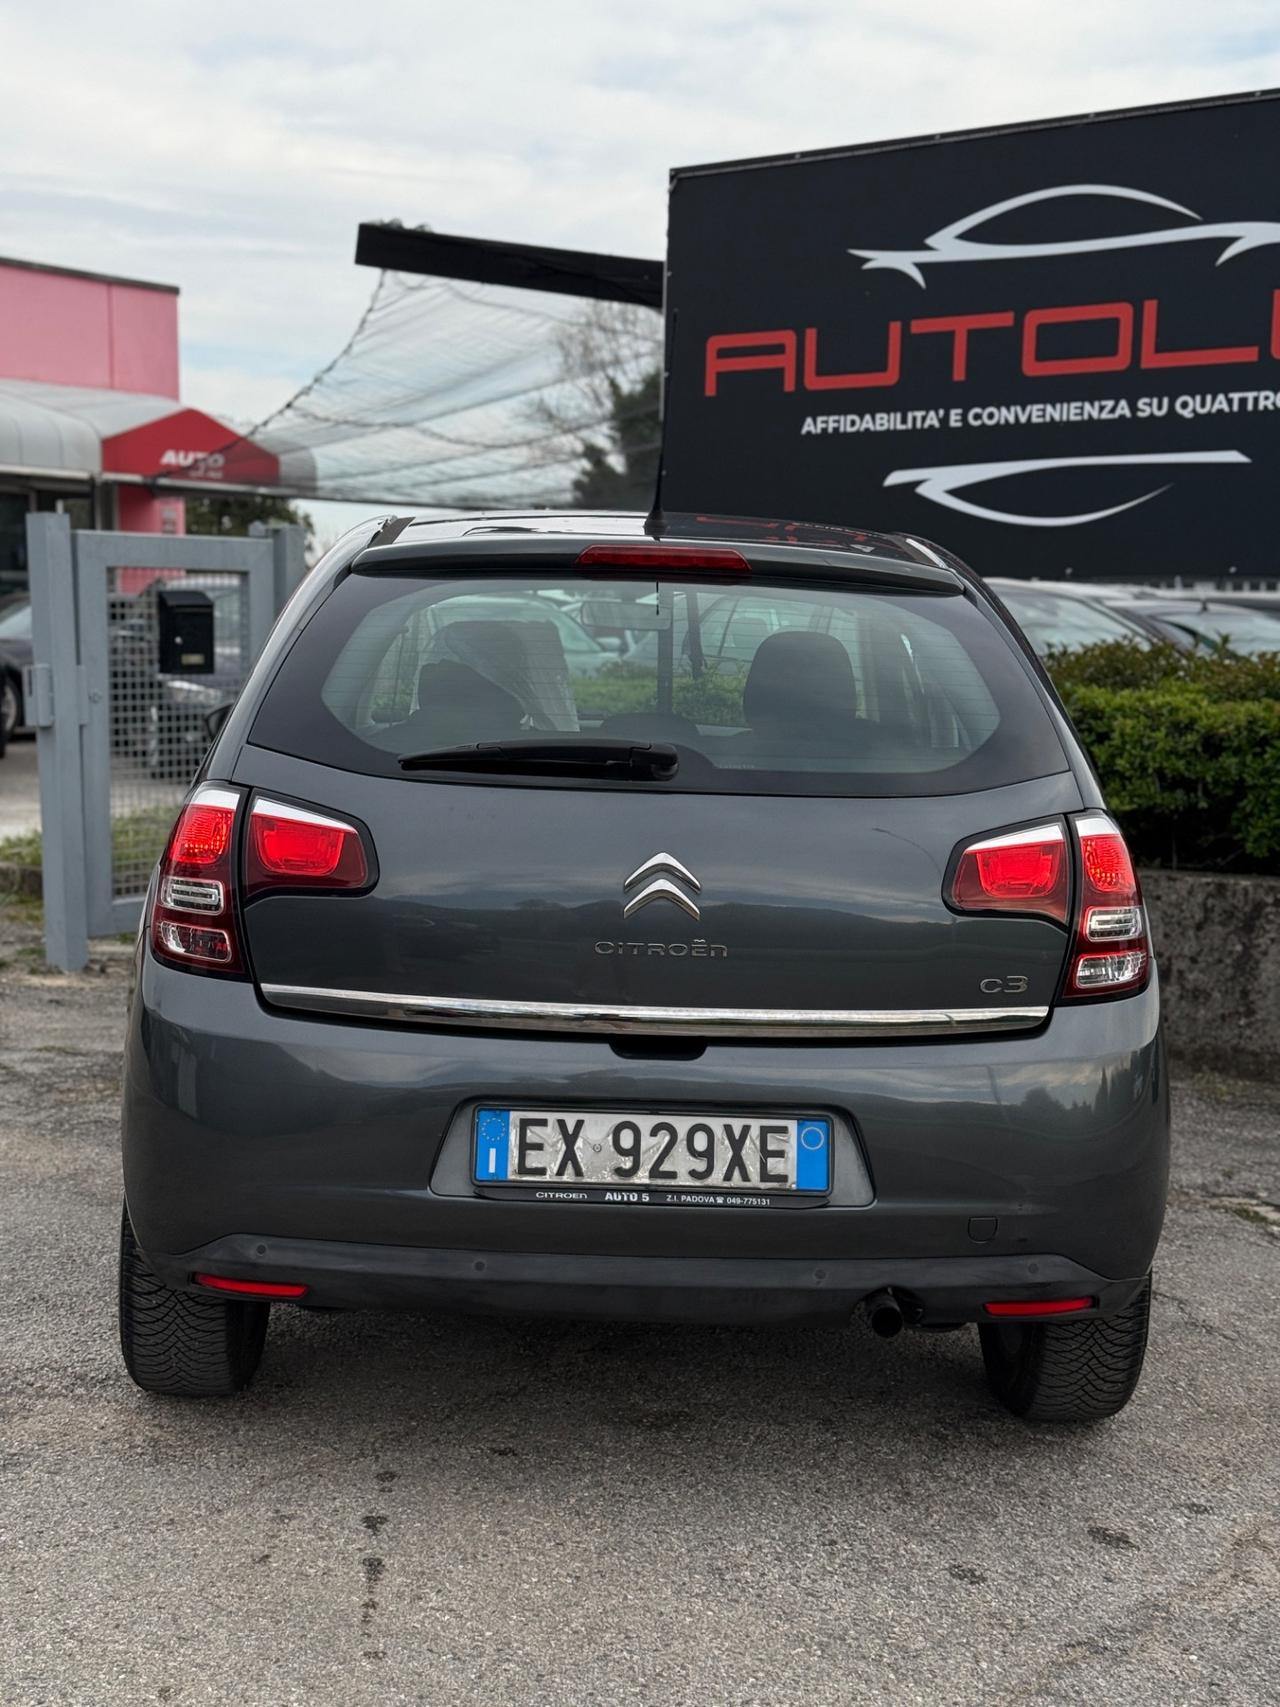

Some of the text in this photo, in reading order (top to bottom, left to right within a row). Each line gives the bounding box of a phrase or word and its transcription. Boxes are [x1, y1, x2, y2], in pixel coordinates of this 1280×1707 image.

[704, 288, 1280, 396] AUTOL
[949, 408, 963, 427] E
[968, 397, 1131, 426] CONVENIENZA
[1136, 397, 1169, 417] SU
[1174, 390, 1280, 418] QUATTR
[980, 975, 1028, 993] C3
[517, 1117, 789, 1183] EX 929XE
[605, 1191, 638, 1202] AUTO
[641, 1193, 650, 1202] 5
[681, 1195, 715, 1204] PADOVA
